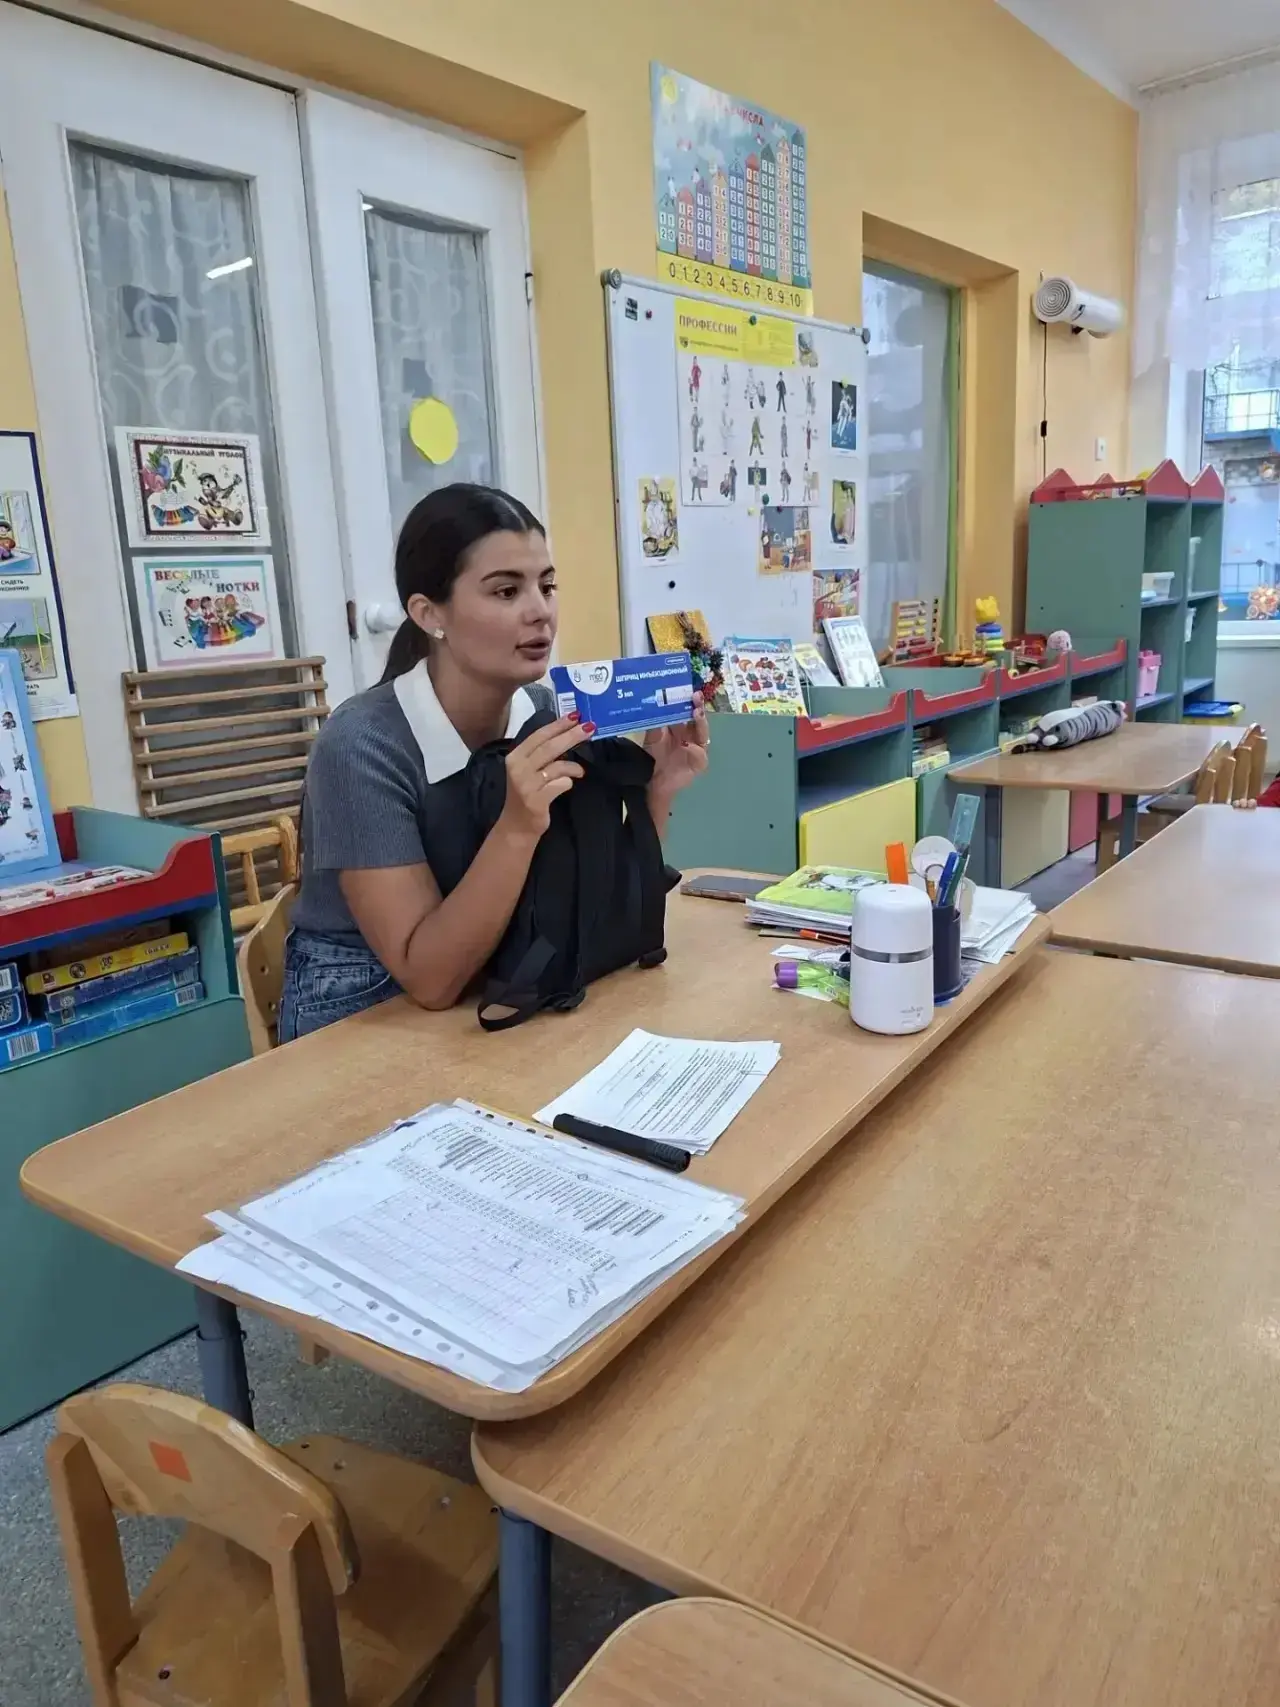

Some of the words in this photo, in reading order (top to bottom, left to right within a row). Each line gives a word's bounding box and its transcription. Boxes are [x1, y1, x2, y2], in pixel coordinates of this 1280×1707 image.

[669, 262, 676, 278] 0
[683, 266, 688, 280] 1
[694, 269, 700, 284] 2
[706, 272, 713, 286] 3
[719, 277, 725, 289] 4
[732, 279, 738, 292] 5
[744, 281, 750, 296] 6
[756, 285, 761, 298] 7
[767, 287, 773, 301] 8
[778, 290, 784, 304] 9
[790, 294, 800, 307] 10
[679, 314, 737, 336] ПРОФЕССИИ
[216, 581, 260, 593] НОТКИ
[615, 673, 639, 683] ШПРИЦ
[640, 665, 688, 680] ИНЪЕКЦИОННЫЙ
[616, 688, 624, 699] 3
[624, 690, 634, 698] мл
